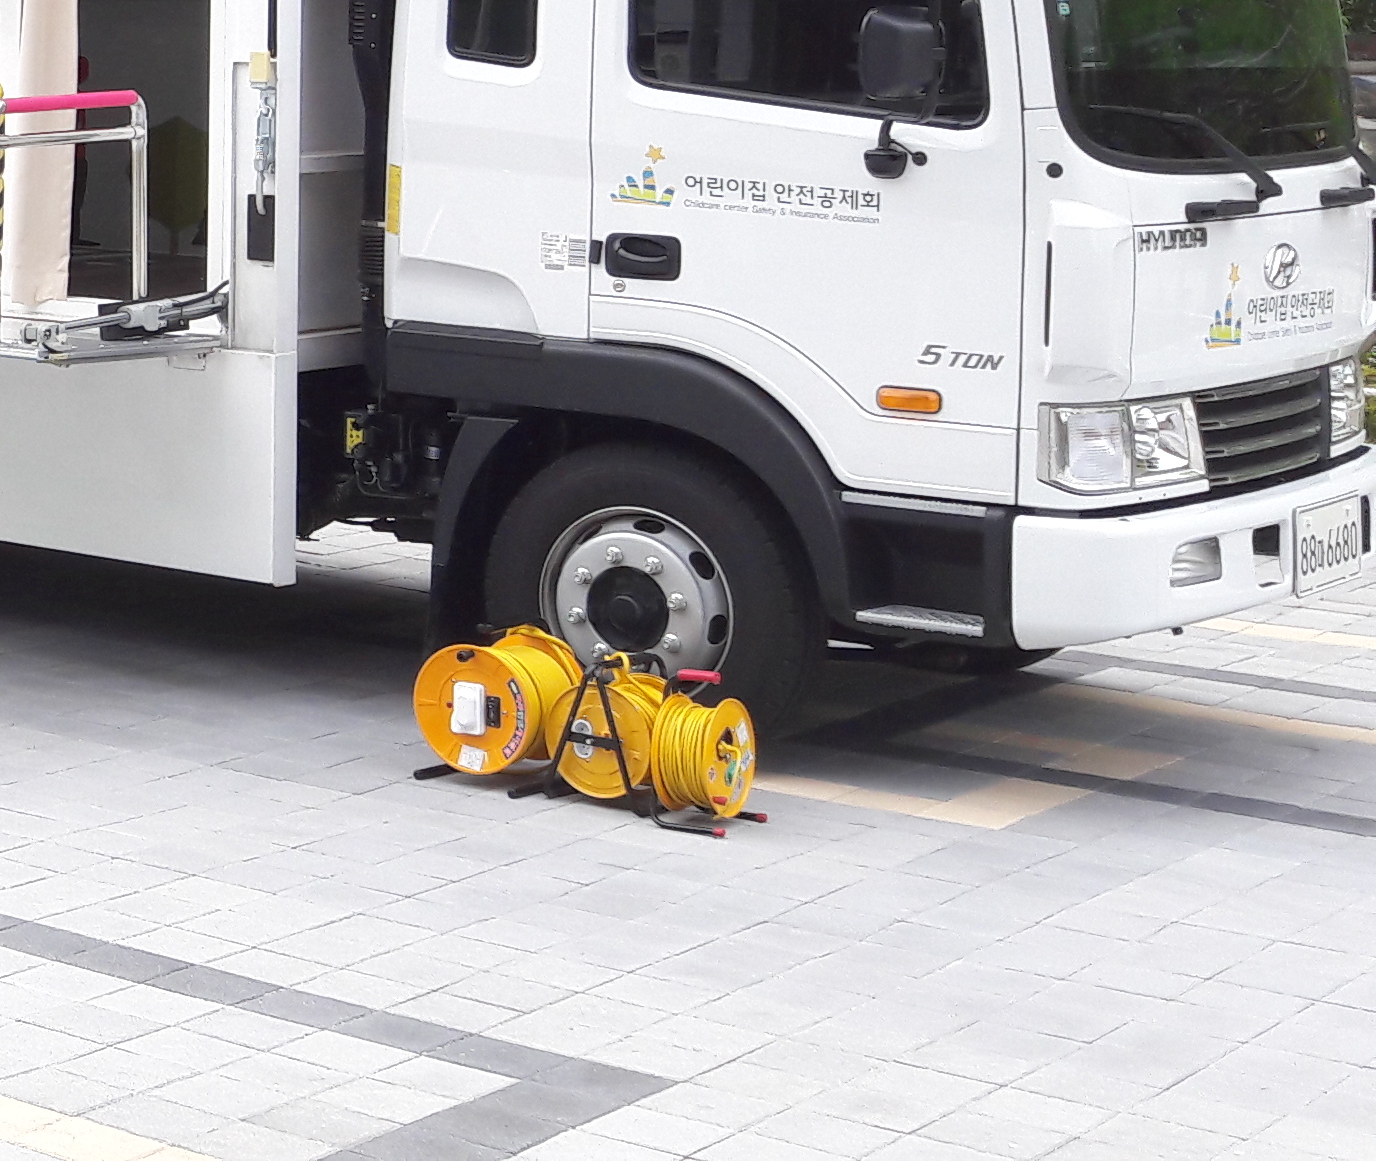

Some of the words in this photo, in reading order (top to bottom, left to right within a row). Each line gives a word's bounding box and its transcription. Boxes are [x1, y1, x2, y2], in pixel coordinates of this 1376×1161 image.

[684, 175, 767, 202] 어린이집
[773, 182, 882, 212] 안전공제회
[1248, 295, 1289, 325] 어린이집
[916, 344, 948, 366] 5
[948, 351, 1005, 371] TON
